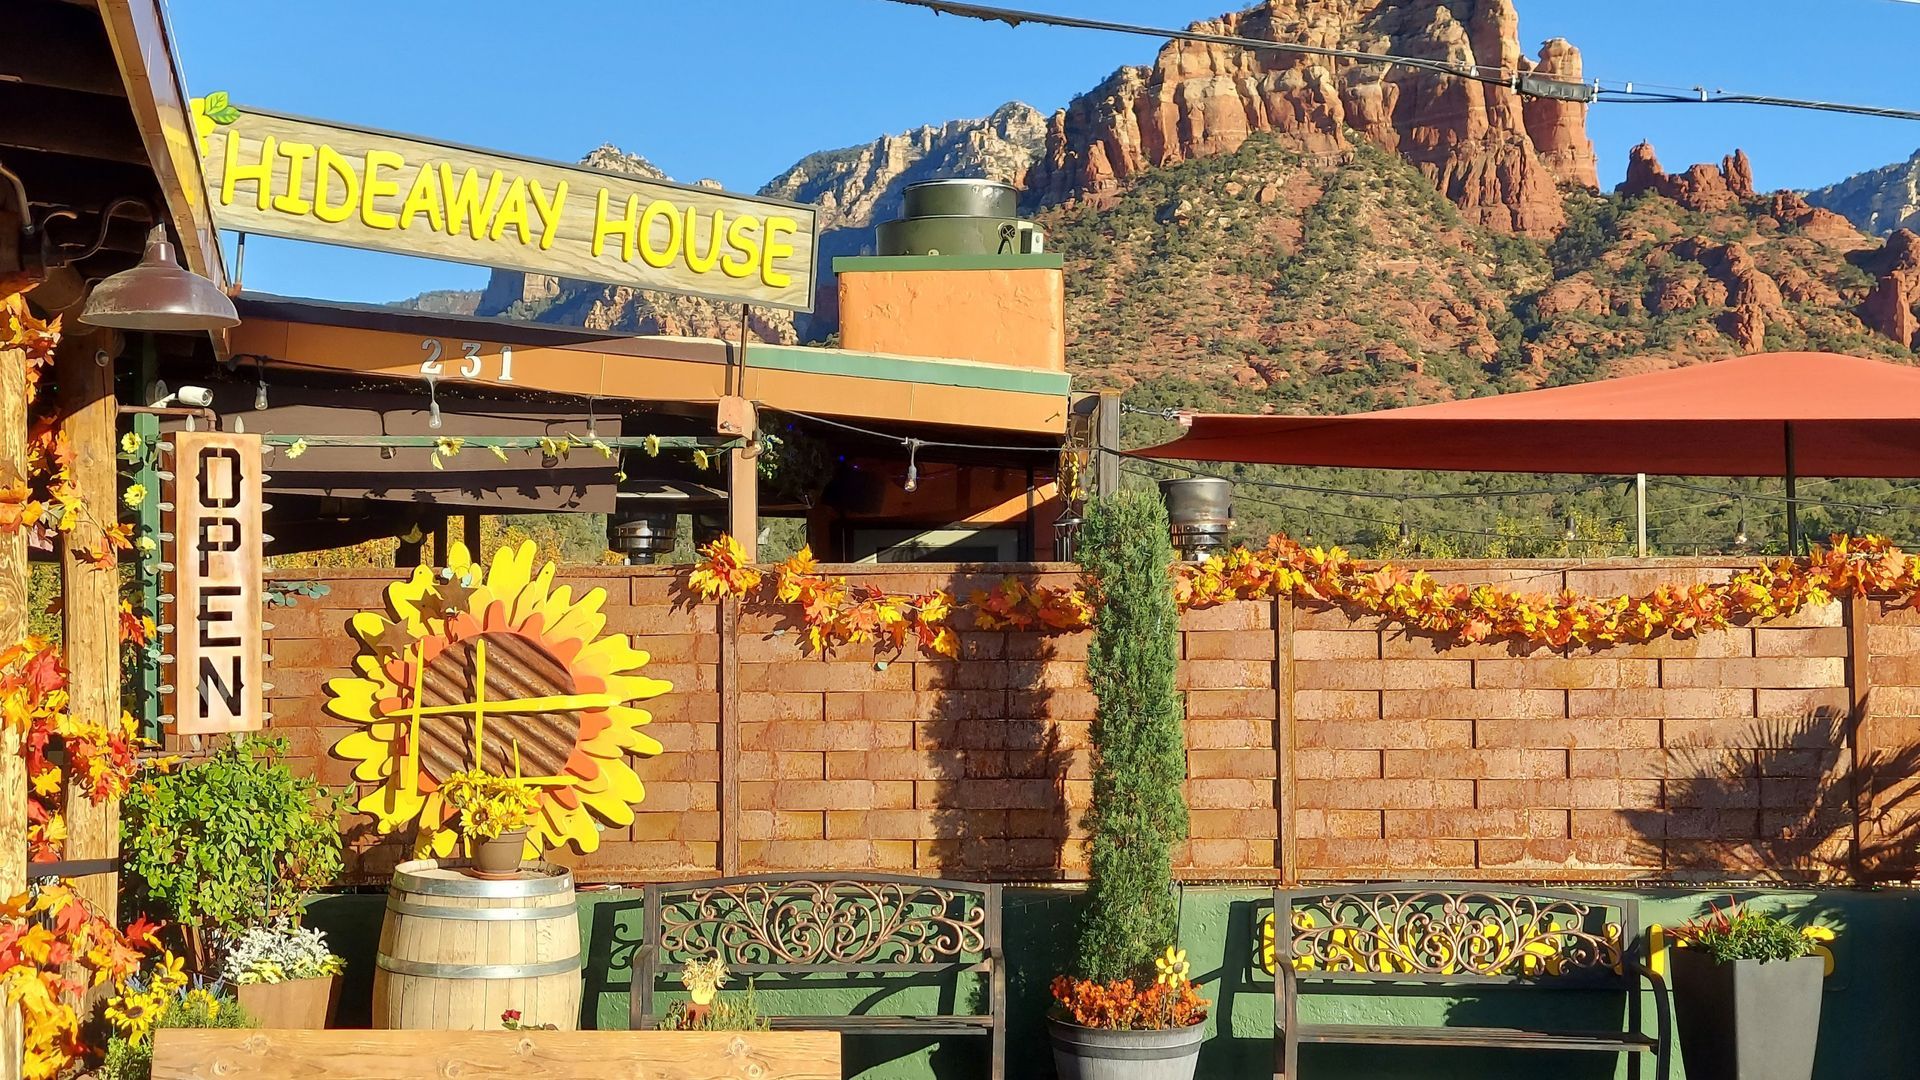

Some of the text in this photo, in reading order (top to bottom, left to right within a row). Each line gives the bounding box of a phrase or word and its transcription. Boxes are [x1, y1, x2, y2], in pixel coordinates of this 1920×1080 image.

[221, 130, 799, 288] HIDEAWAY HOUSE
[420, 338, 513, 381] 231
[196, 446, 244, 719] OPEN
